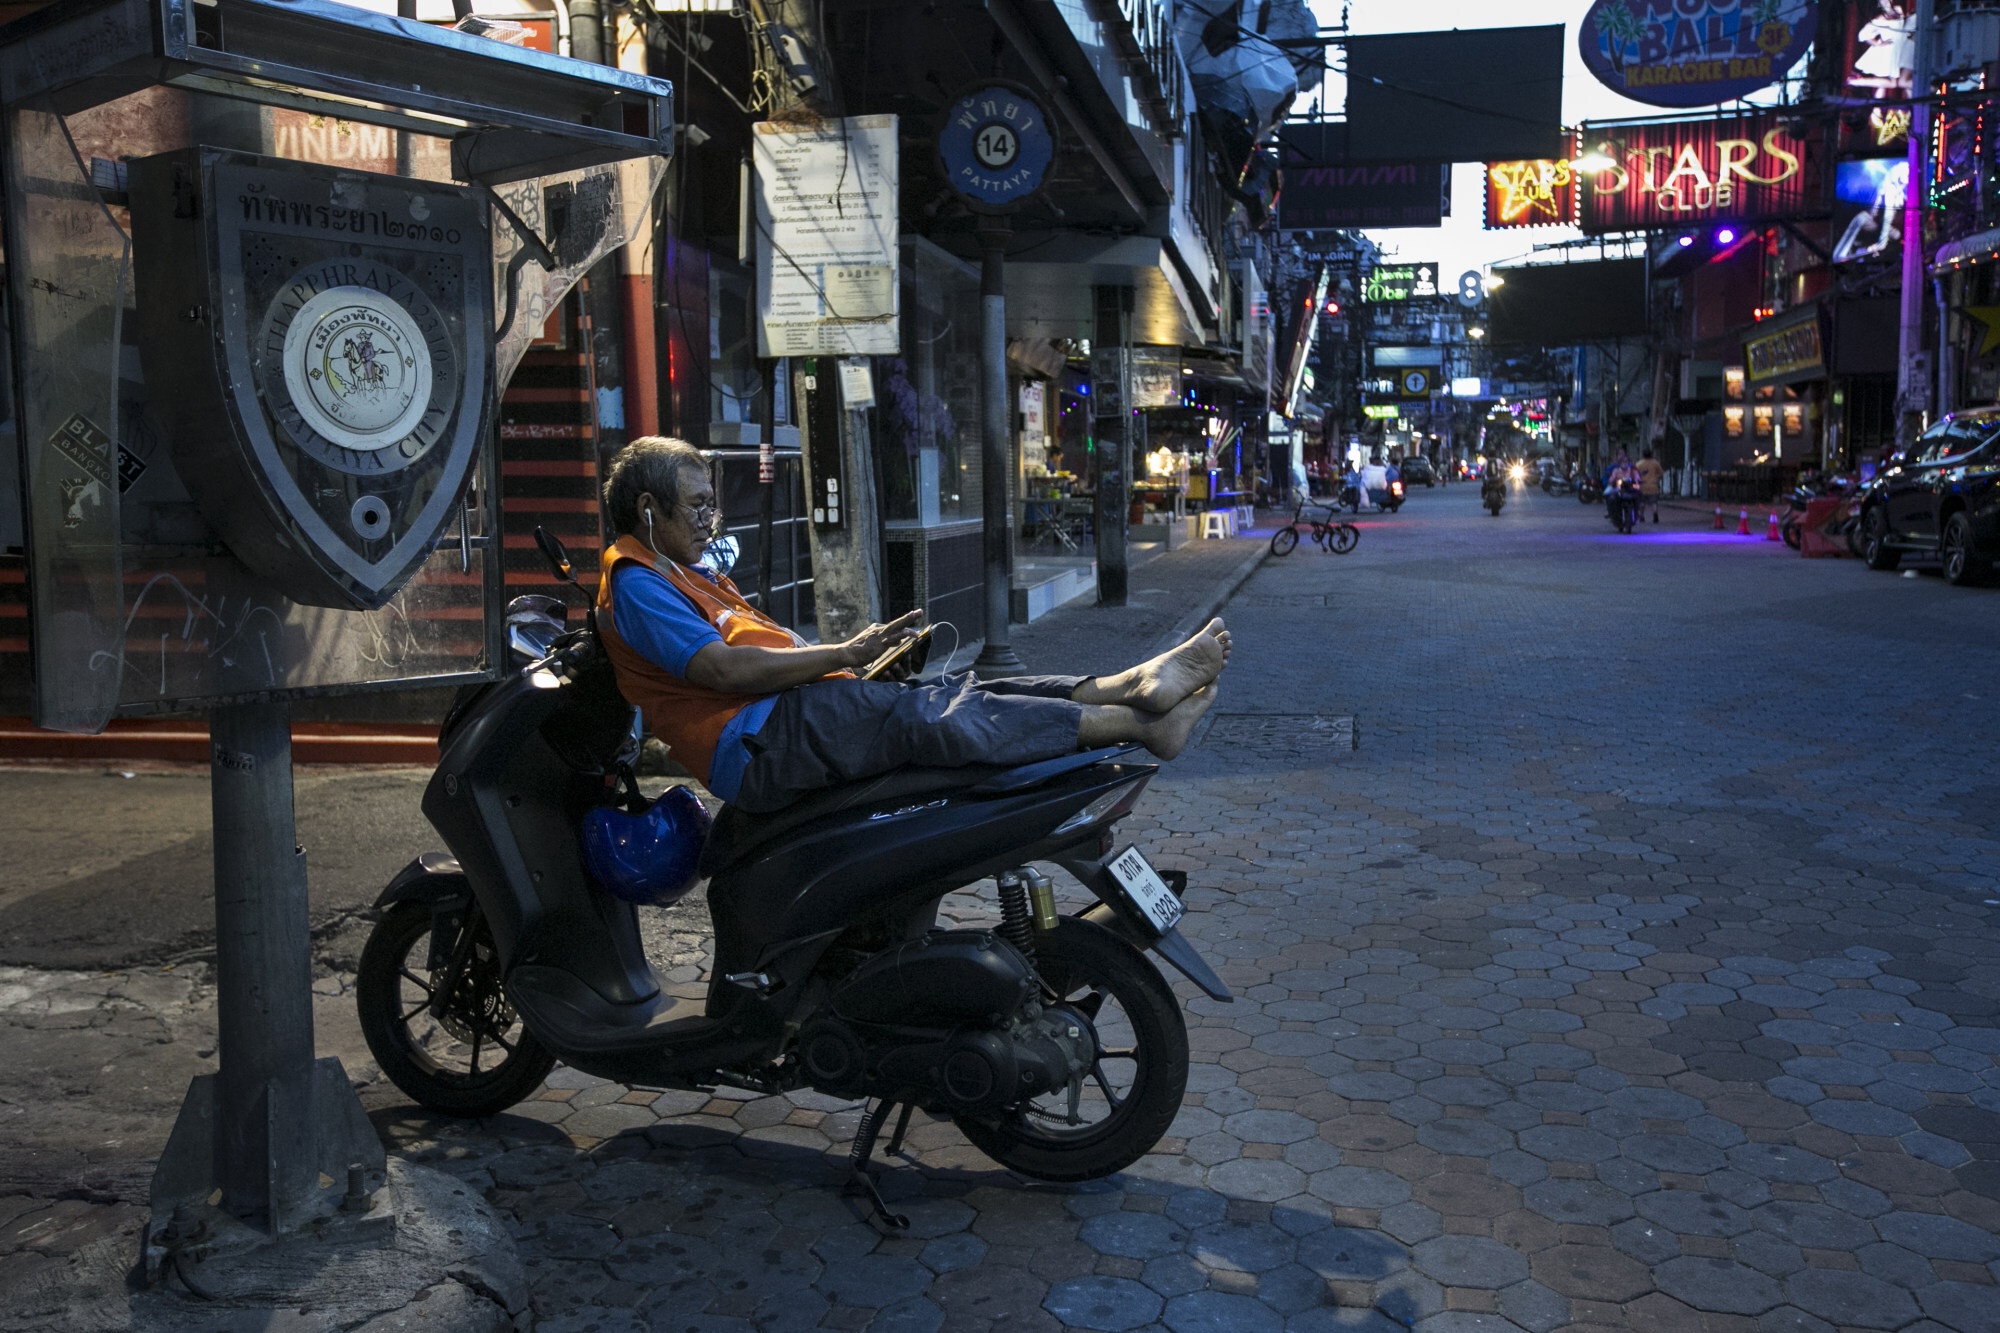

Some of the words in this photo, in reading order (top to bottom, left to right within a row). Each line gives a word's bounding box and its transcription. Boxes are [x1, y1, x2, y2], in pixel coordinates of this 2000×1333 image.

[1639, 15, 1762, 62] BALL
[1626, 60, 1723, 88] KARAOKE
[1729, 56, 1772, 79] BAR
[958, 99, 1033, 131] พัทยา
[982, 134, 1009, 157] 14
[1593, 125, 1799, 196] STARS
[961, 166, 1032, 192] PATTAYA
[1299, 164, 1416, 187] MIAMI
[1489, 157, 1571, 188] STARS
[1512, 184, 1553, 201] CLUB
[1656, 182, 1734, 211] CLUB
[397, 397, 447, 460] CITY
[1151, 893, 1179, 925] 1928
